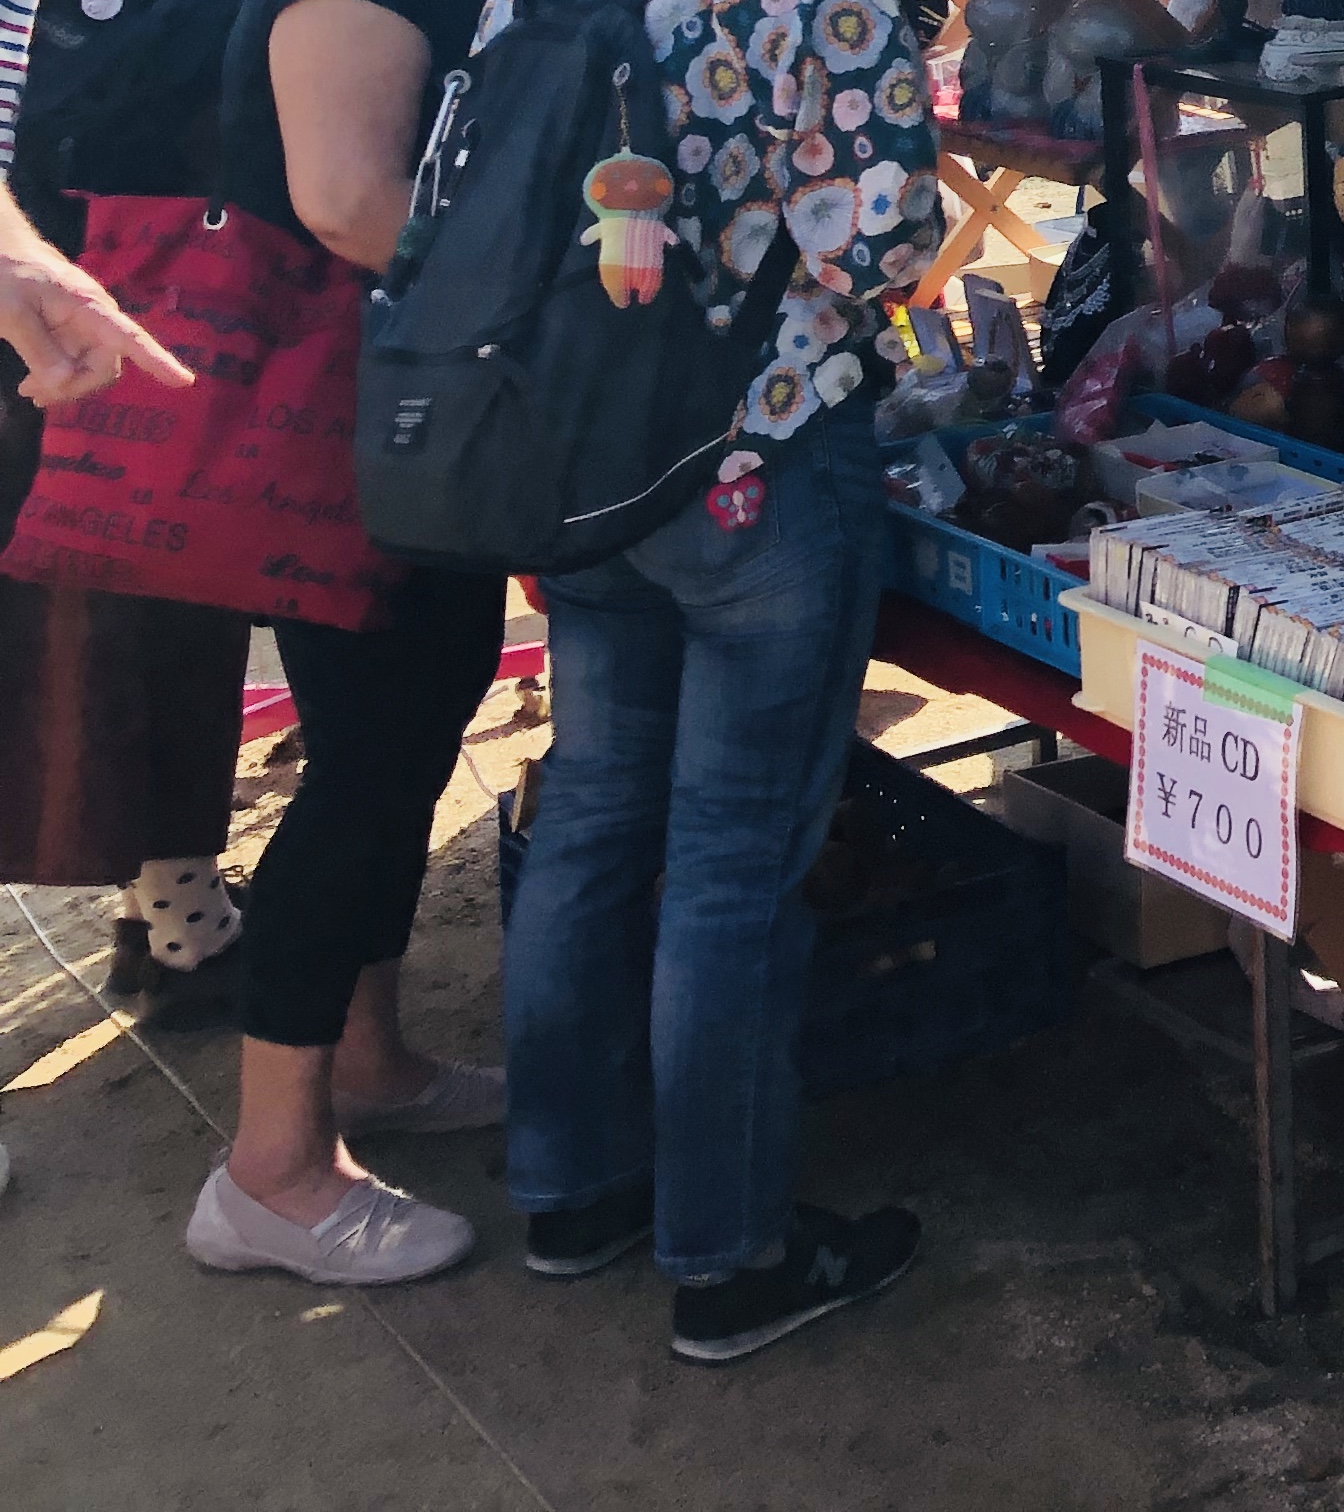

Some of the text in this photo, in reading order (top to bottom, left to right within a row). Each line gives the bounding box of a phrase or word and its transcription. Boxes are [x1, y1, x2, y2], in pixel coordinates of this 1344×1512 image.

[1162, 701, 1260, 782] 新品 CD
[1156, 771, 1262, 860] ¥700
